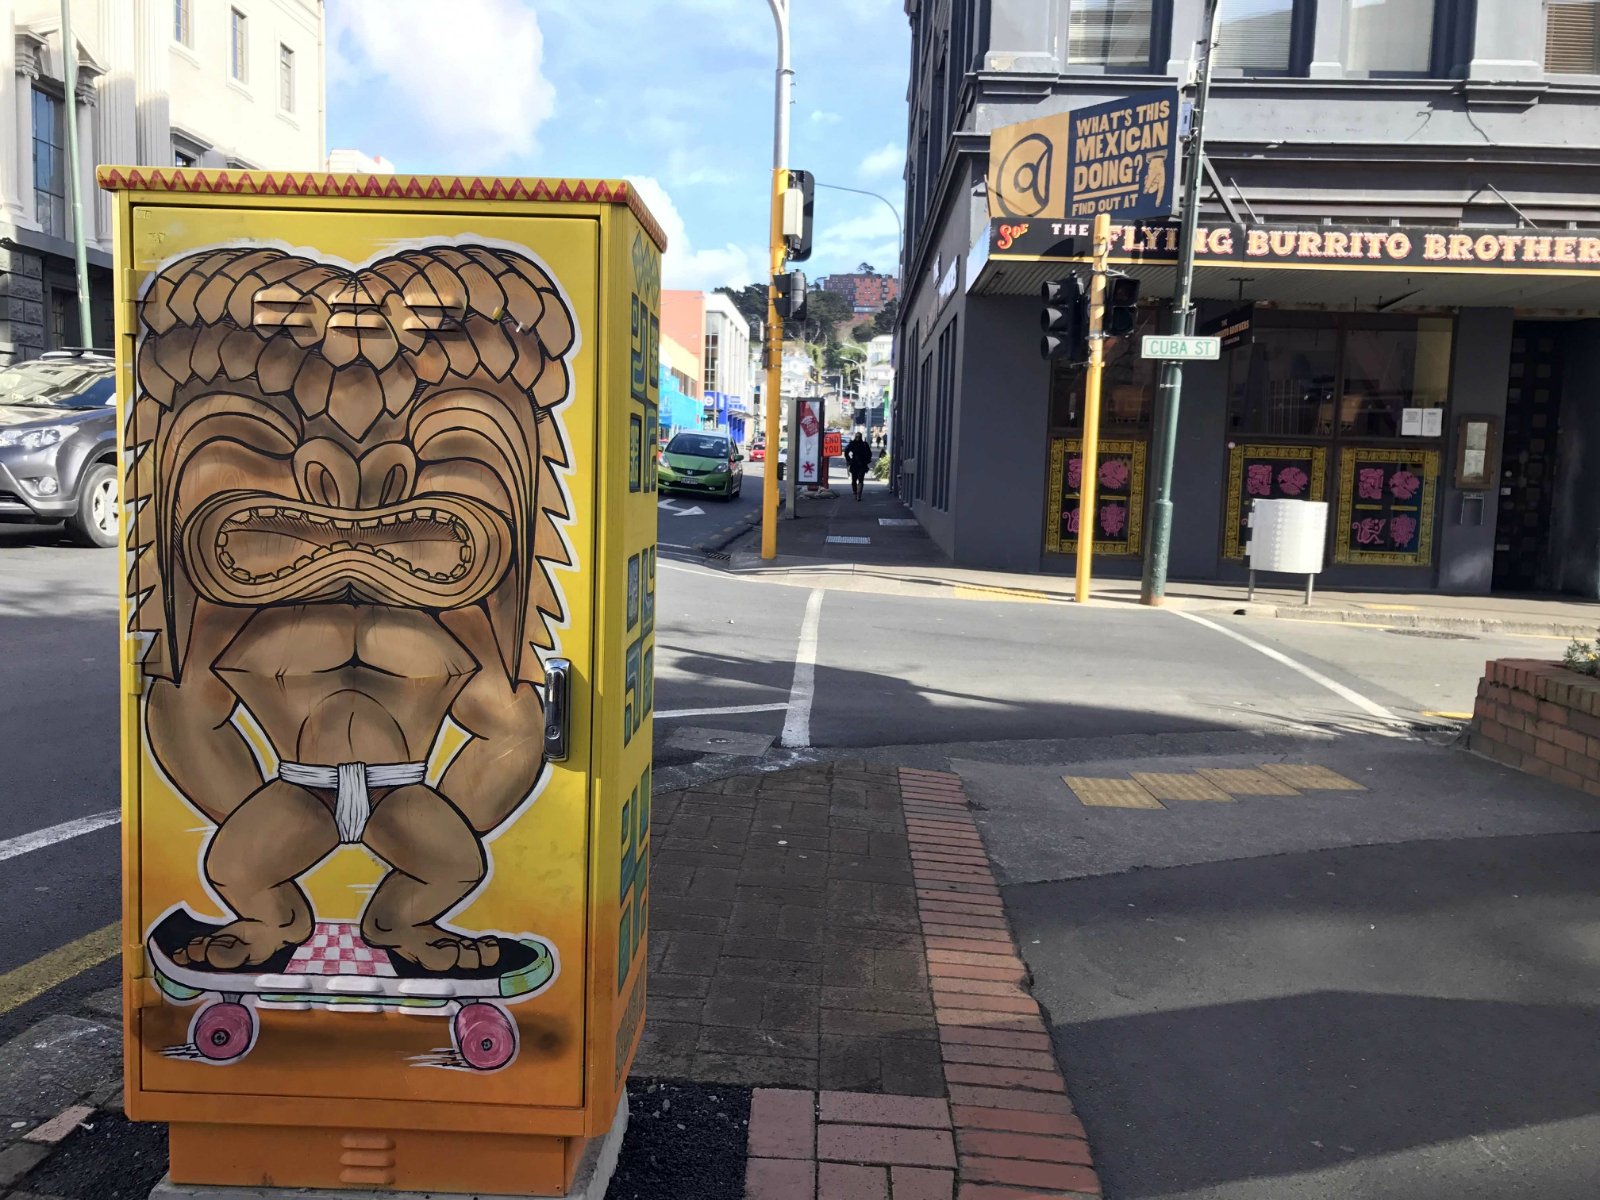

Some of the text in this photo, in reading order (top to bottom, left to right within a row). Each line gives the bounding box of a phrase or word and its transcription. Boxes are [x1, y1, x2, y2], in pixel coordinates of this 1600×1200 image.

[1076, 100, 1170, 137] WHAT'S THIS
[1075, 120, 1169, 163] MEXICAN
[1073, 154, 1143, 193] DOING?
[1072, 194, 1139, 217] FIND OUT AT
[1051, 223, 1090, 237] THE
[1246, 229, 1412, 260] BURRITO
[1150, 340, 1212, 355] CUBA ST
[825, 445, 839, 453] YOU
